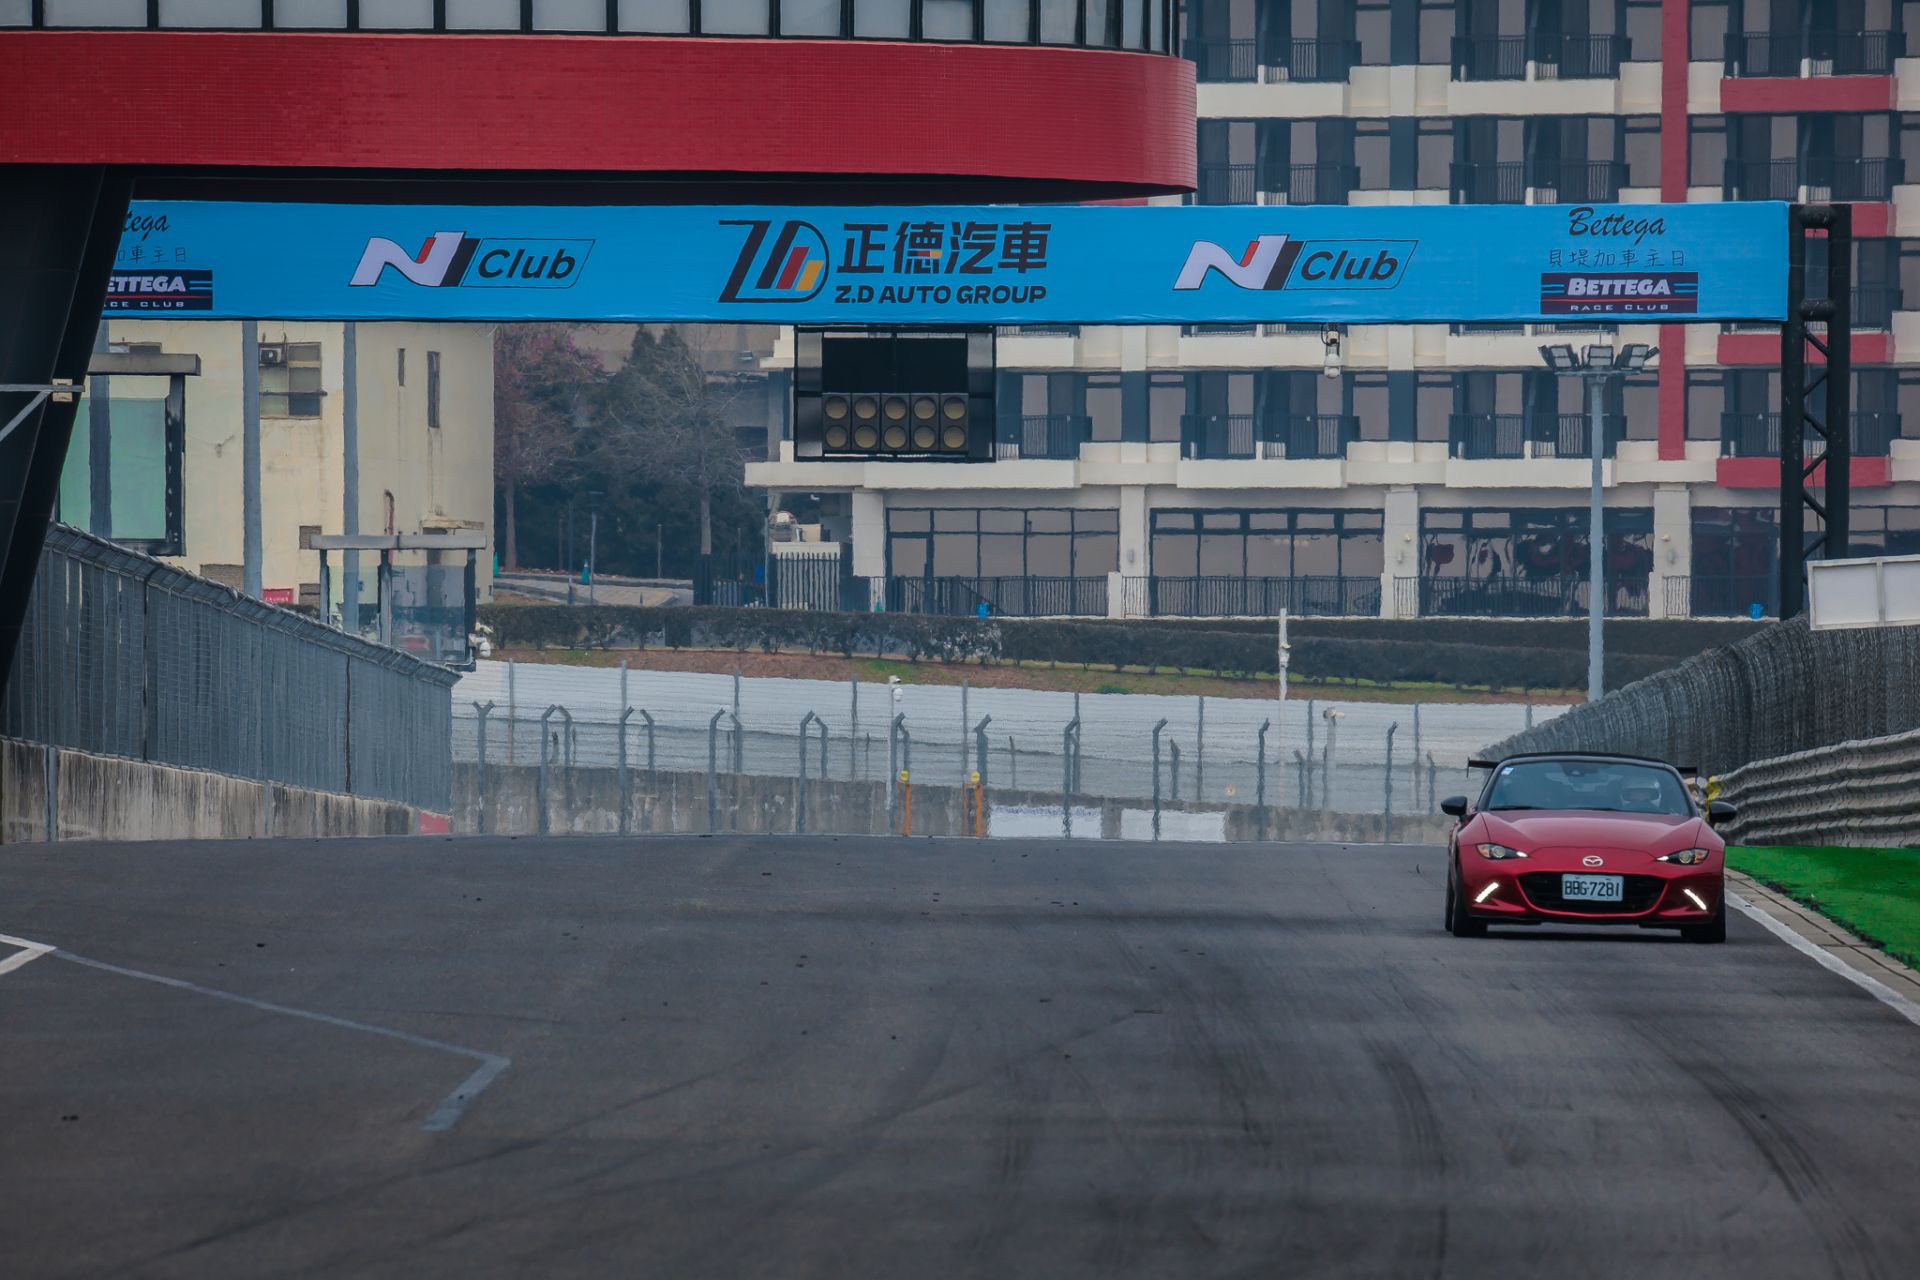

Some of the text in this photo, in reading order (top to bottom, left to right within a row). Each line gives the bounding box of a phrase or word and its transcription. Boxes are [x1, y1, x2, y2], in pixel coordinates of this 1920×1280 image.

[1568, 206, 1667, 245] Bettega
[477, 248, 576, 279] Club
[836, 221, 1051, 275] 正德汽車
[1300, 249, 1399, 281] Club
[834, 285, 1047, 304] Z.D AUTO GROUP
[1567, 277, 1671, 296] BETTEGA
